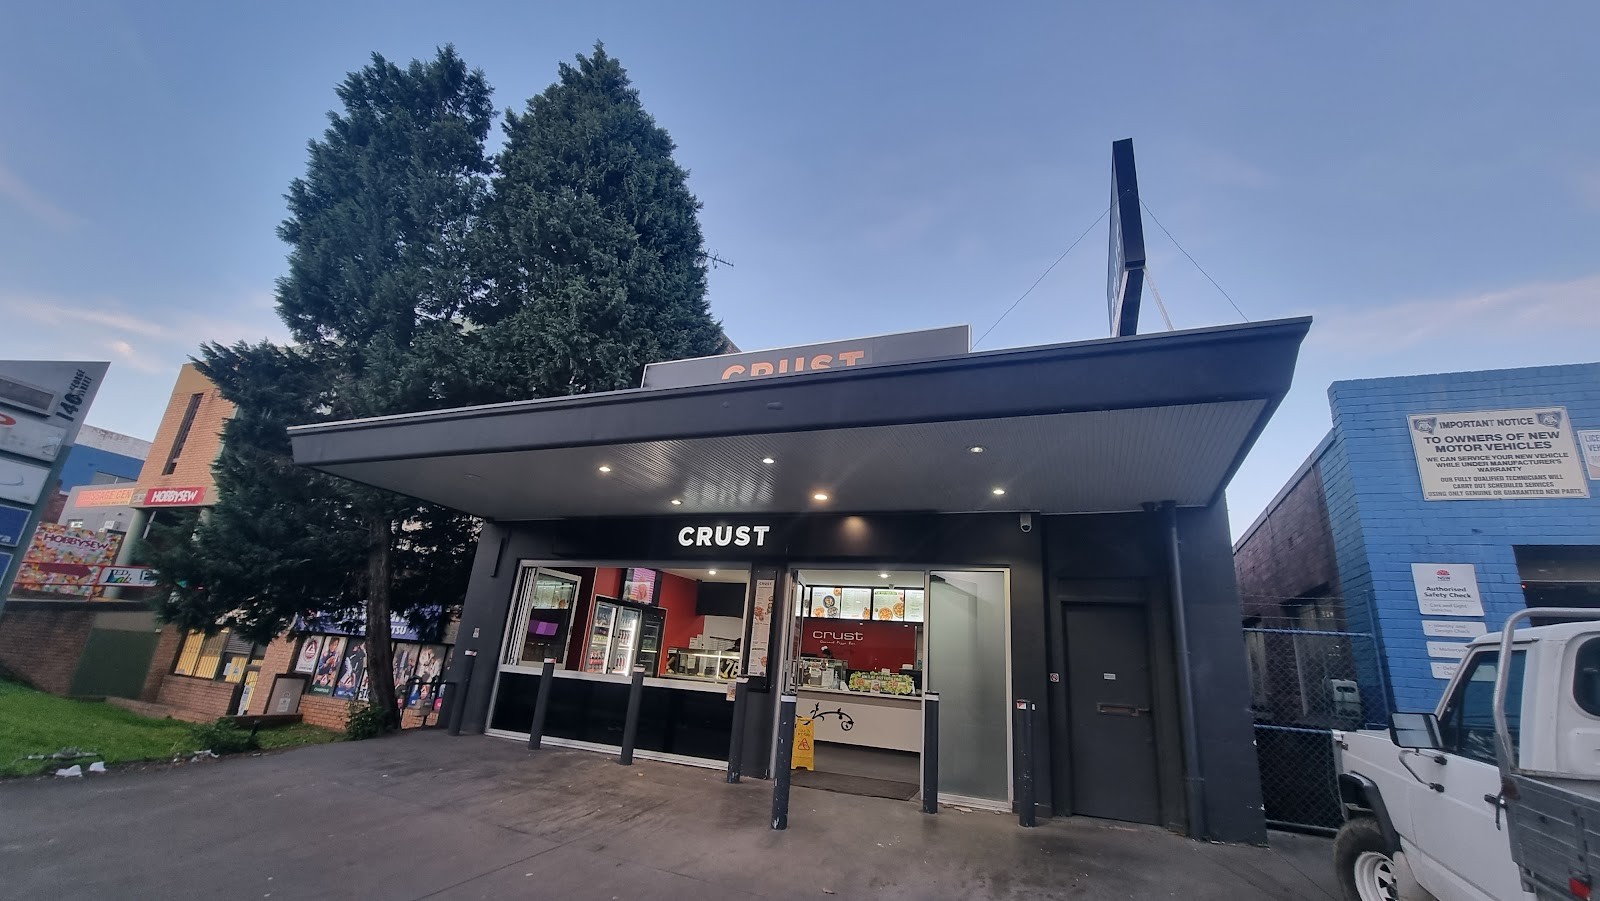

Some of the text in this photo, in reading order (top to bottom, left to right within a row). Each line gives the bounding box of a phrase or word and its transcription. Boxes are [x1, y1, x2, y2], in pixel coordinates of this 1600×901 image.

[1439, 417, 1535, 429] IMPORTANT NOTICE
[1424, 431, 1560, 444] TO OWNERS OF NEW
[1435, 441, 1552, 453] MOTOR VEHICLES
[151, 490, 198, 503] HOBBYSEW
[43, 533, 110, 551] HOBBYSEW
[678, 525, 770, 547] CRUST
[812, 631, 864, 641] crust
